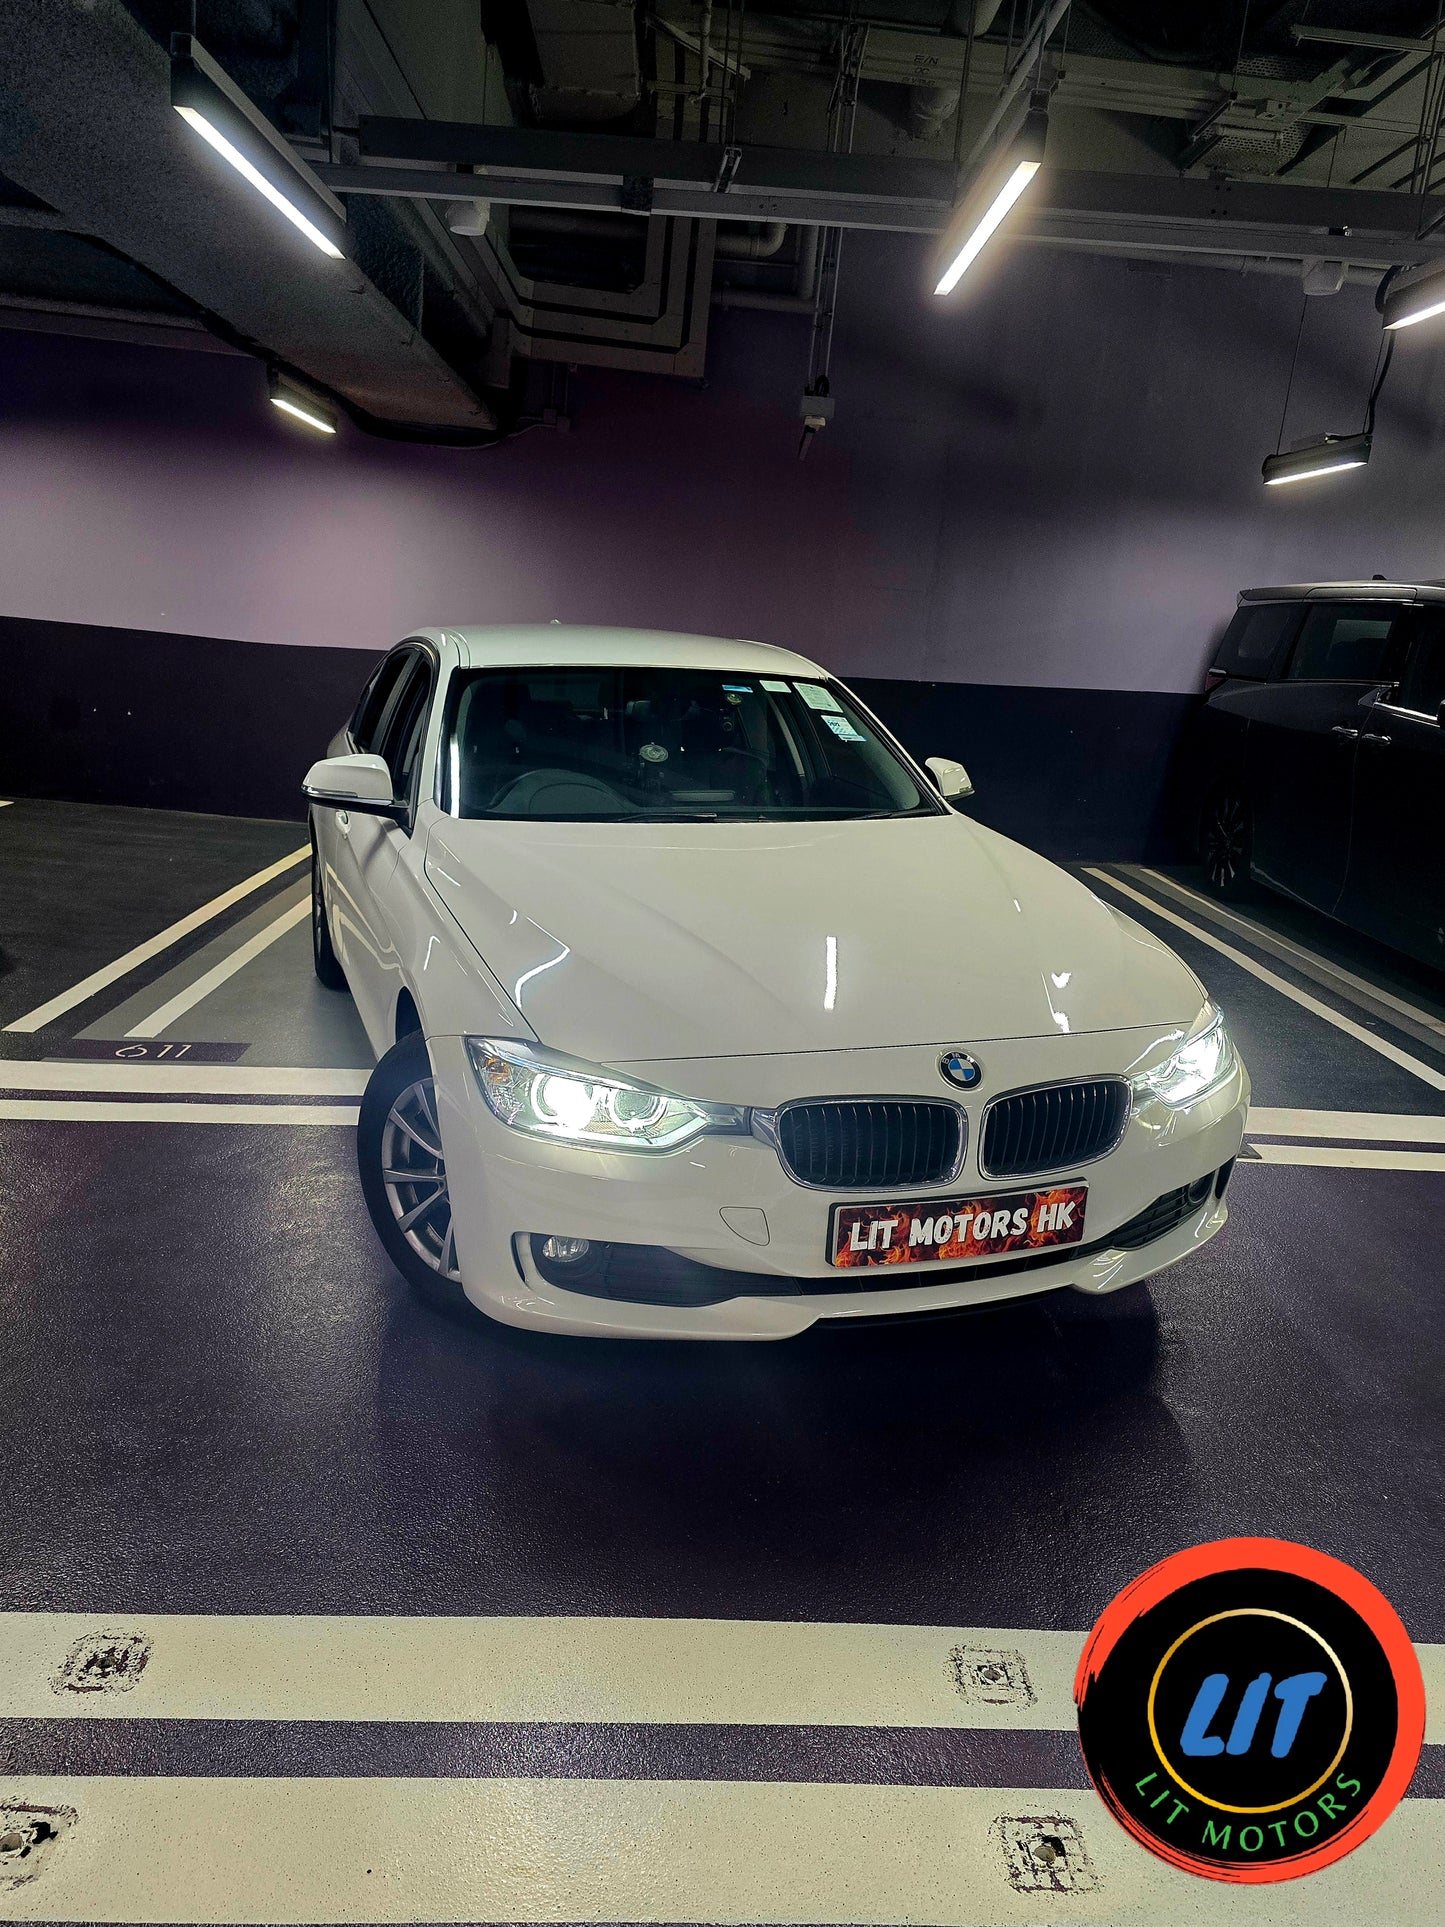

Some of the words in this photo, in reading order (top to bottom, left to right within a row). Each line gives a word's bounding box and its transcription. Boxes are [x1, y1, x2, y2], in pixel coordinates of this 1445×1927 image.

[114, 1044, 192, 1058] 611
[849, 1220, 899, 1252] LIT
[908, 1207, 1028, 1247] MOTORS
[1036, 1201, 1077, 1232] HK
